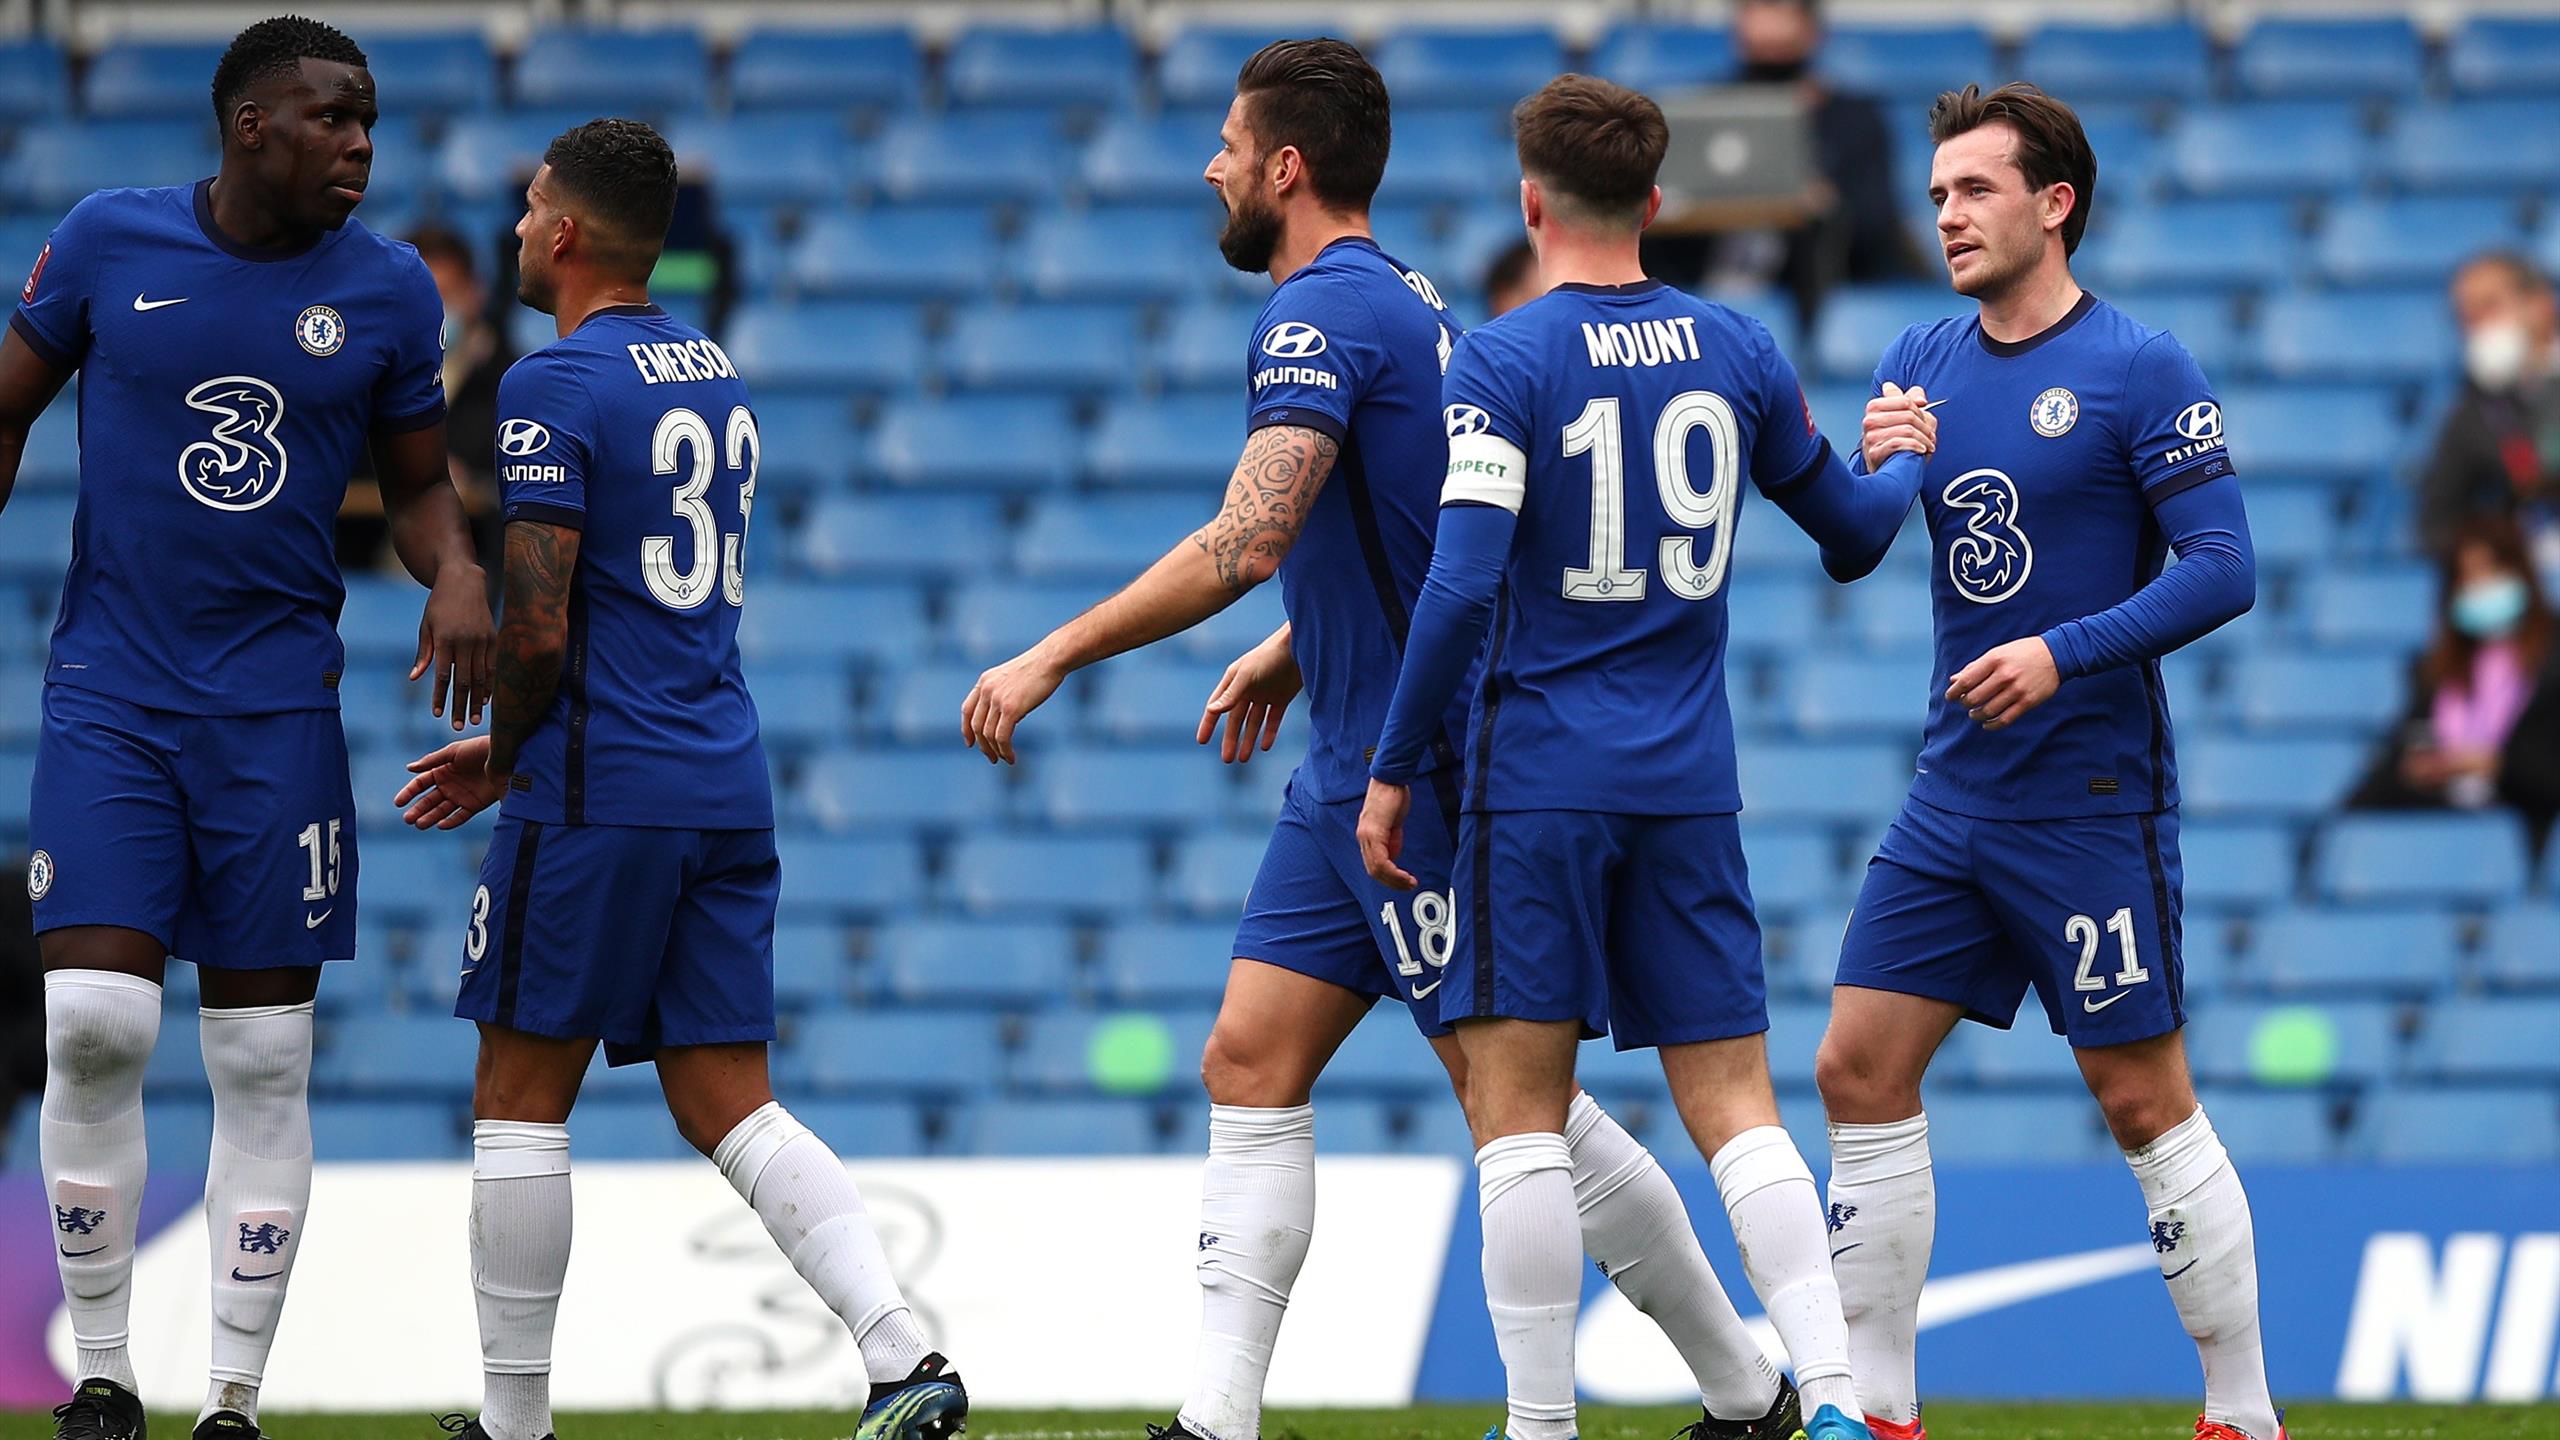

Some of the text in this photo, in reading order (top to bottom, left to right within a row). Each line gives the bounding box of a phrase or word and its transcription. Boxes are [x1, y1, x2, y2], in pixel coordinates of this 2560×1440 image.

[306, 307, 338, 321] CHELSEA
[1581, 316, 1701, 368] MOUNT
[627, 339, 739, 384] EMERSON
[1253, 366, 1337, 392] HYUNDAI
[502, 464, 565, 483] UNDAI
[641, 405, 759, 609] 33
[1562, 390, 1740, 602] 19
[298, 817, 341, 901] 15
[1380, 887, 1457, 977] 18
[2064, 907, 2150, 992] 21
[2334, 1231, 2560, 1404] NI
